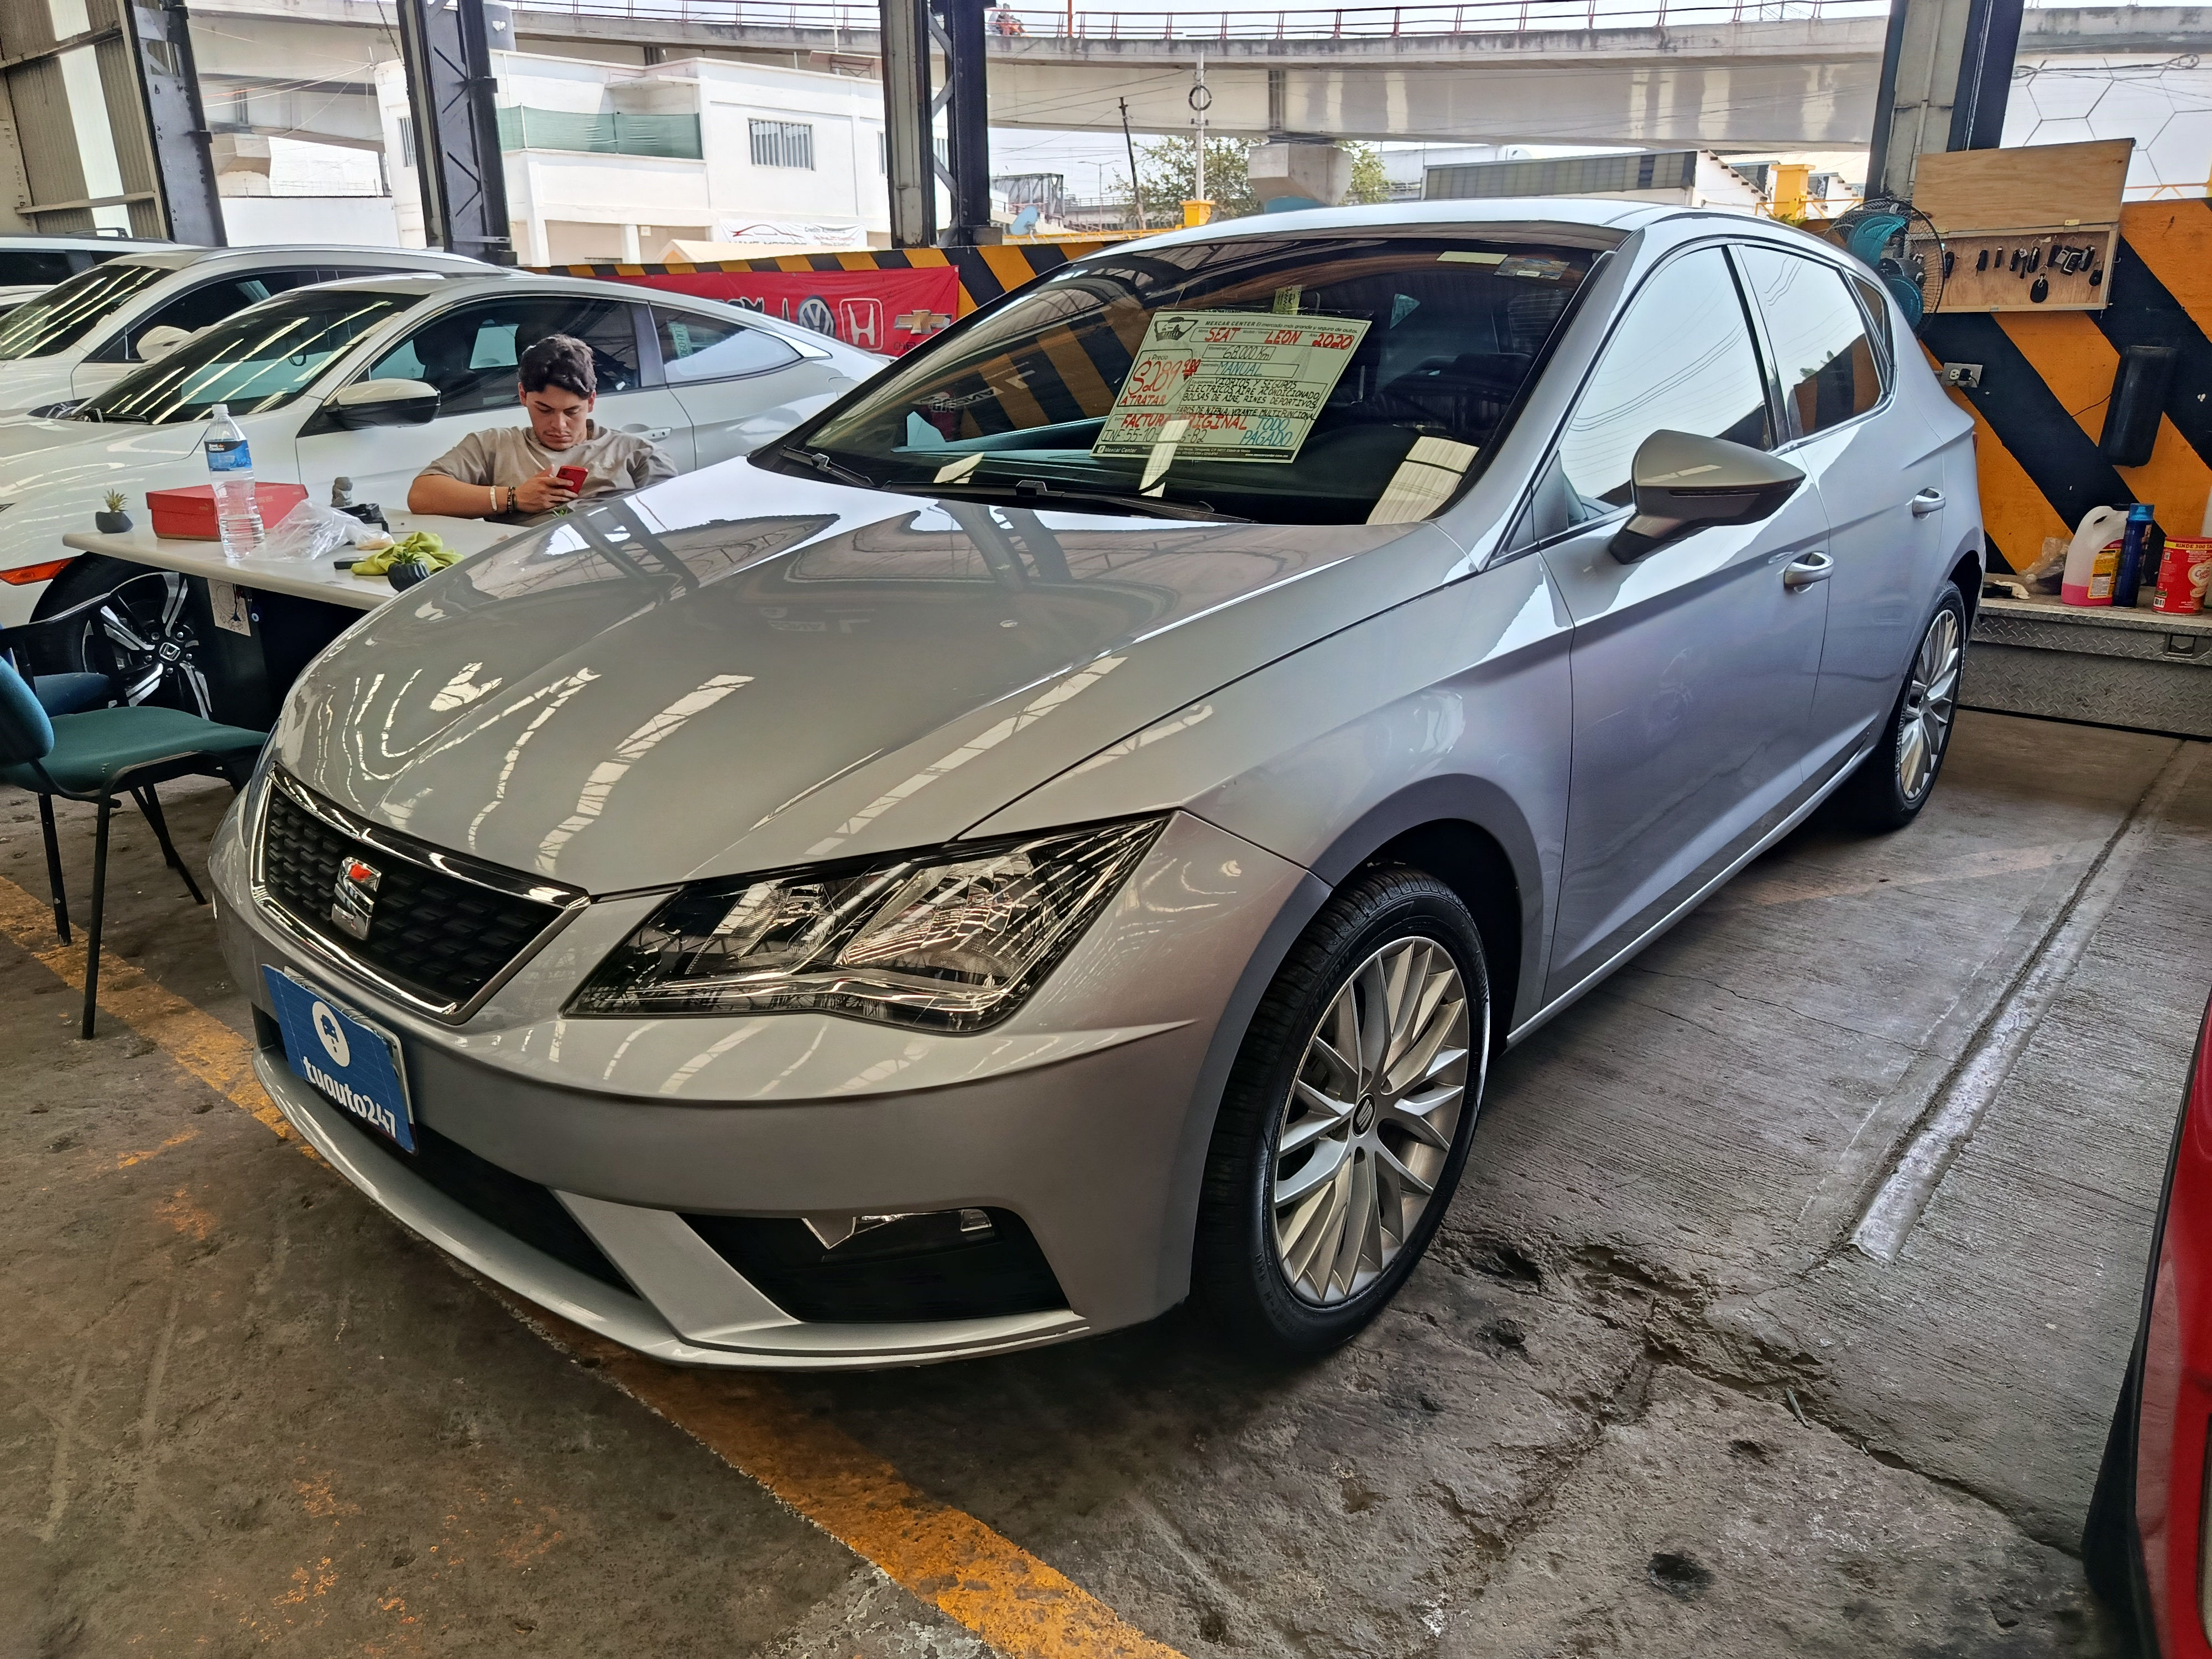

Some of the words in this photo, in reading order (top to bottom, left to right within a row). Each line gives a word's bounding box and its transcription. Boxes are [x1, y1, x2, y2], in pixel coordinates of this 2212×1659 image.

[1204, 327, 1241, 342] SEAT
[1264, 330, 1303, 345] LEON
[1312, 333, 1354, 349] 2020
[1215, 361, 1262, 376] MANUAL
[1215, 378, 1250, 387] VIDRIOS
[1261, 380, 1297, 390] SEGUROS
[1235, 386, 1256, 395] AIRE
[1120, 395, 1128, 406] A
[1129, 394, 1167, 405] TRATAR
[1182, 392, 1210, 401] BOLSAS
[1211, 393, 1222, 401] DE
[1243, 395, 1267, 404] RINES
[1176, 406, 1195, 414] FAROS
[1196, 406, 1205, 415] DE
[1232, 408, 1259, 416] VOLANTE
[1120, 413, 1171, 429] FACTURA
[1256, 416, 1290, 431] TODO
[1239, 430, 1293, 446] PAGADO
[302, 1056, 396, 1138] tuauto247
